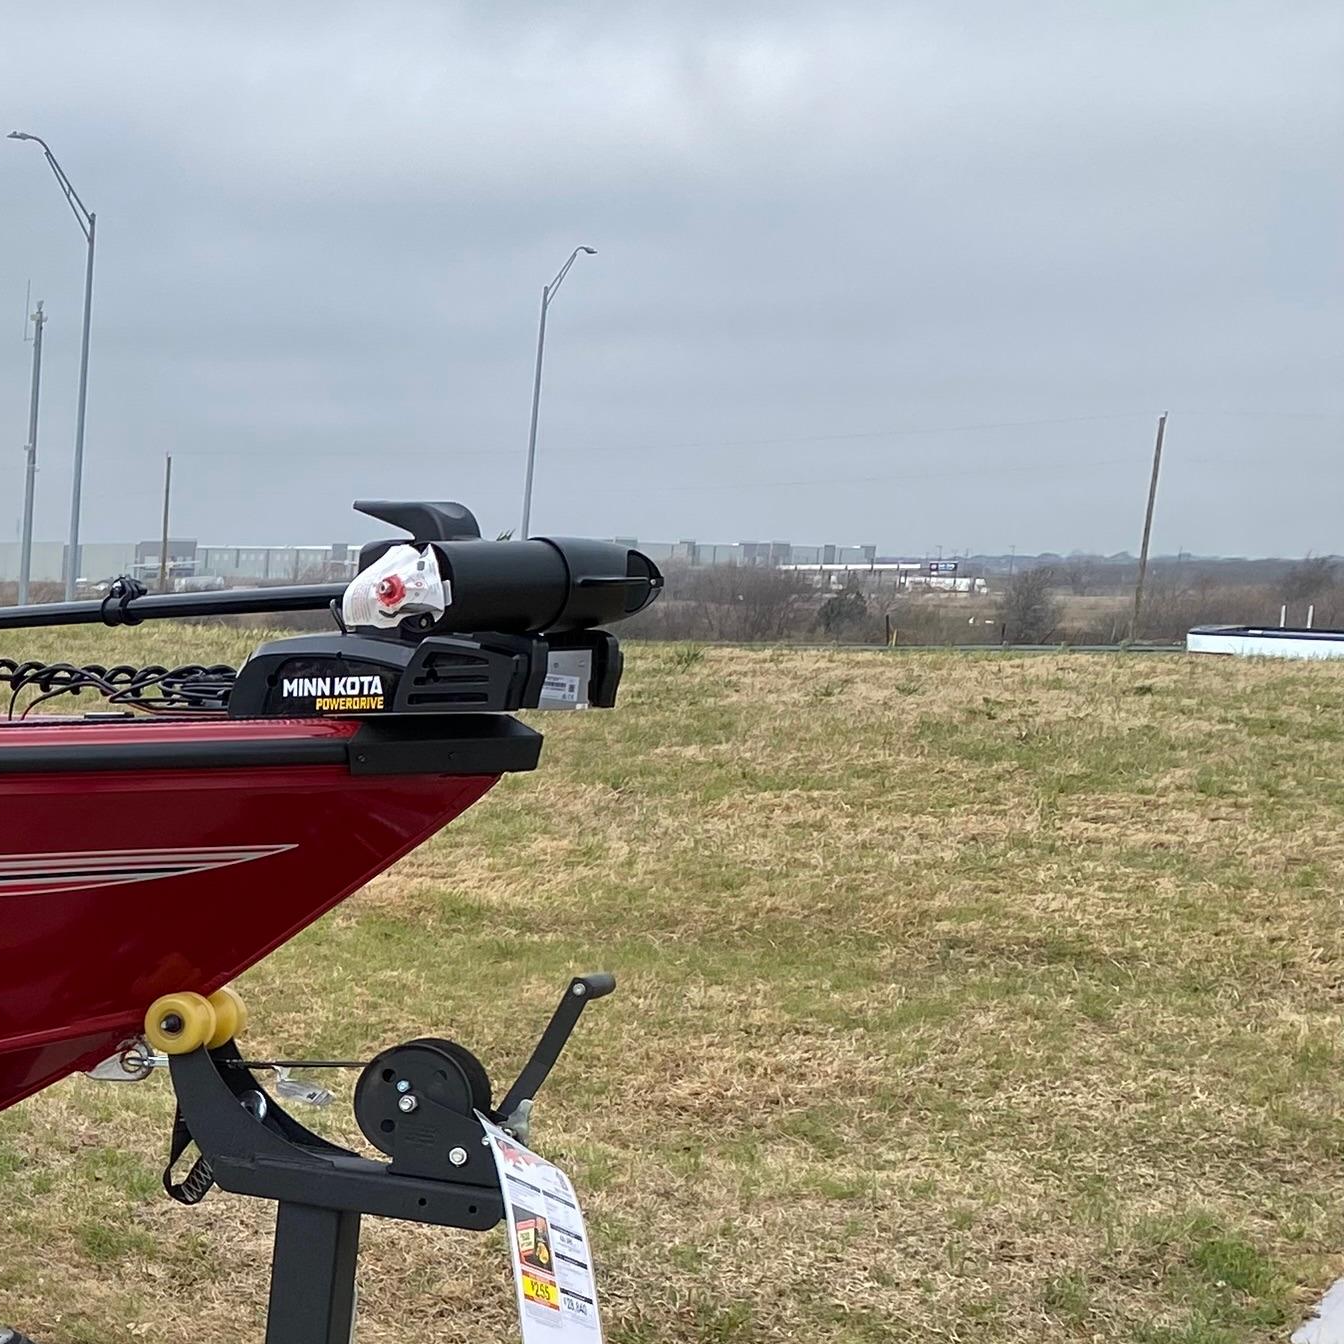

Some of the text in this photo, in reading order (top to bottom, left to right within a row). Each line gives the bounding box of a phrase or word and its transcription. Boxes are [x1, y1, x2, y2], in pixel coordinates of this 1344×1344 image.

[282, 675, 384, 698] MINN KOTA
[315, 696, 385, 710] POWERDRIVE
